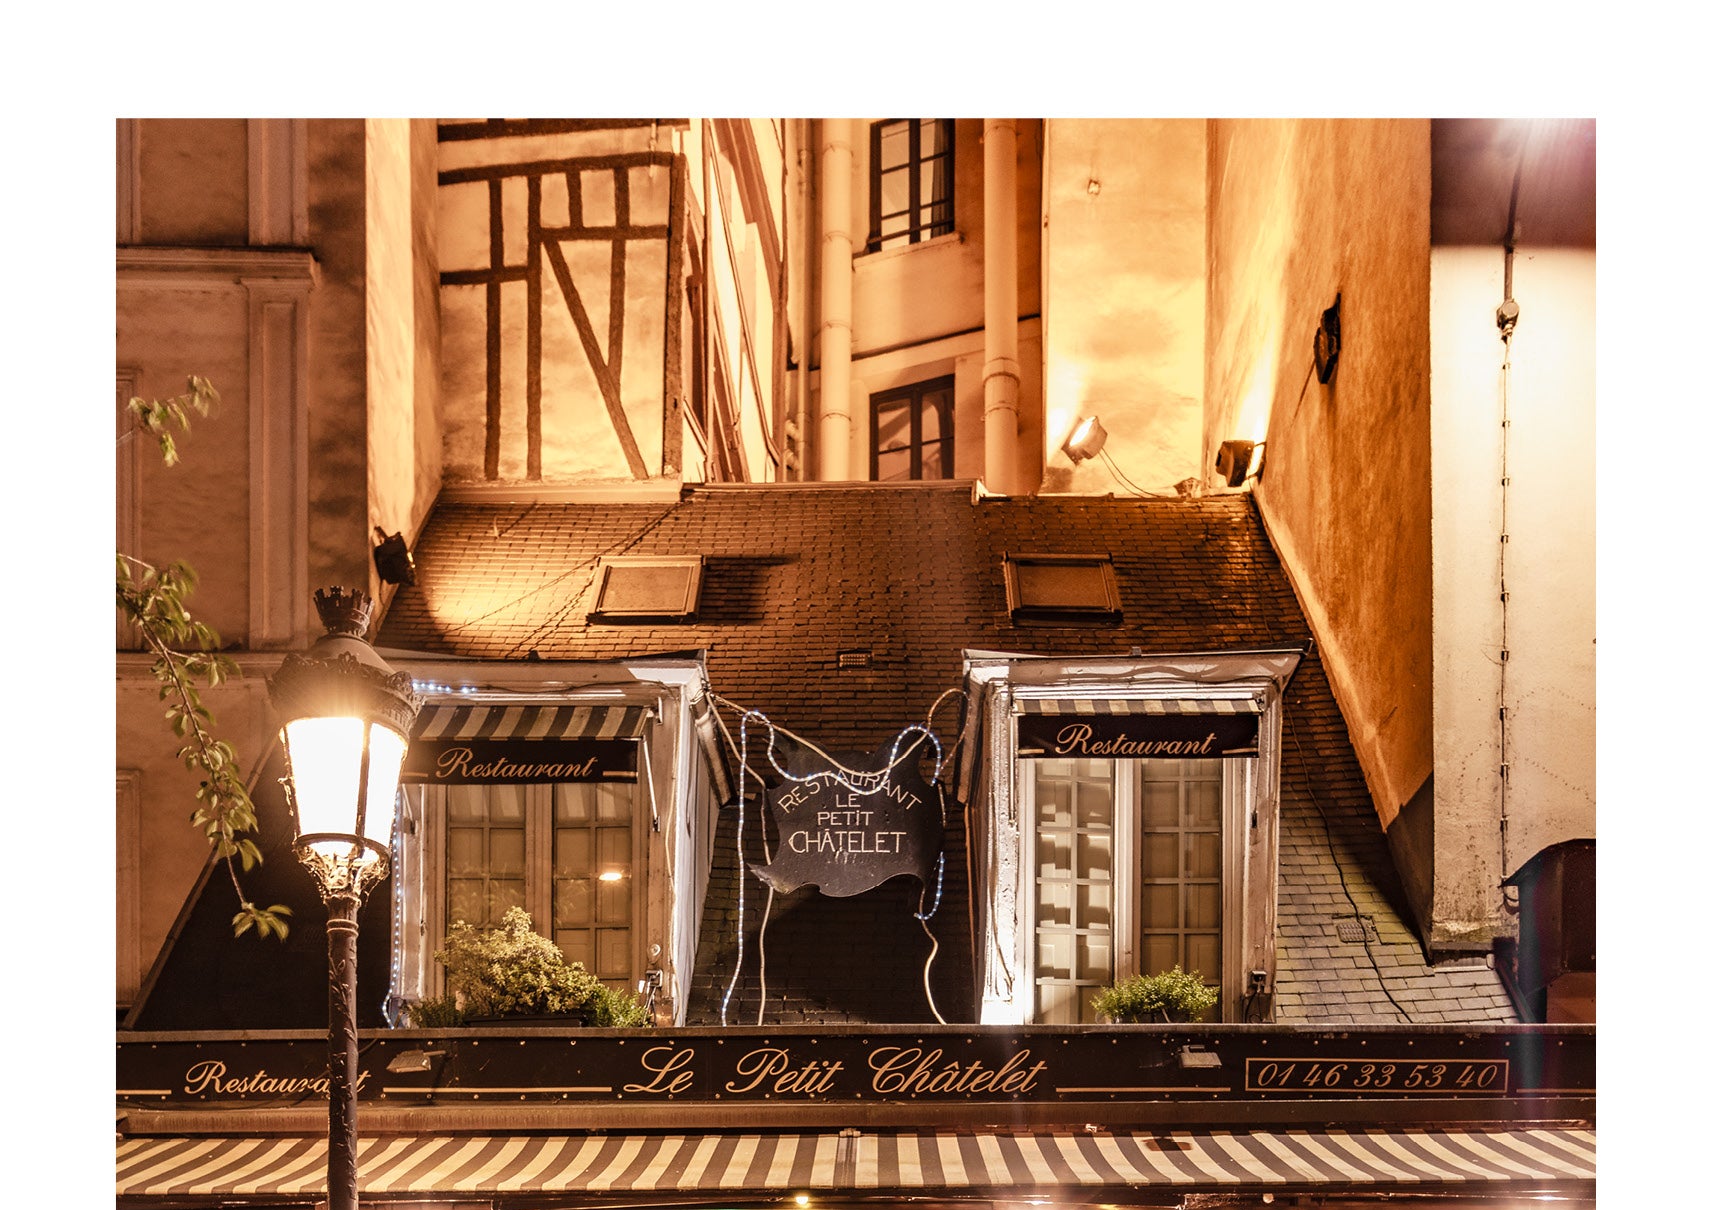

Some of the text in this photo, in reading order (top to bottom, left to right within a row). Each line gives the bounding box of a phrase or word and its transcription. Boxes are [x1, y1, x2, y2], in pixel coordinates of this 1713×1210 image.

[1054, 723, 1217, 755] Restaurant
[435, 747, 598, 779] Restaurant
[777, 769, 922, 814] RESTAURANT
[835, 793, 861, 808] LE
[817, 810, 874, 826] PETIT
[788, 829, 907, 853] CHÂTELET
[184, 1046, 1498, 1095] Restaurat Le Petit Châtelet 01 46 33 53 40
